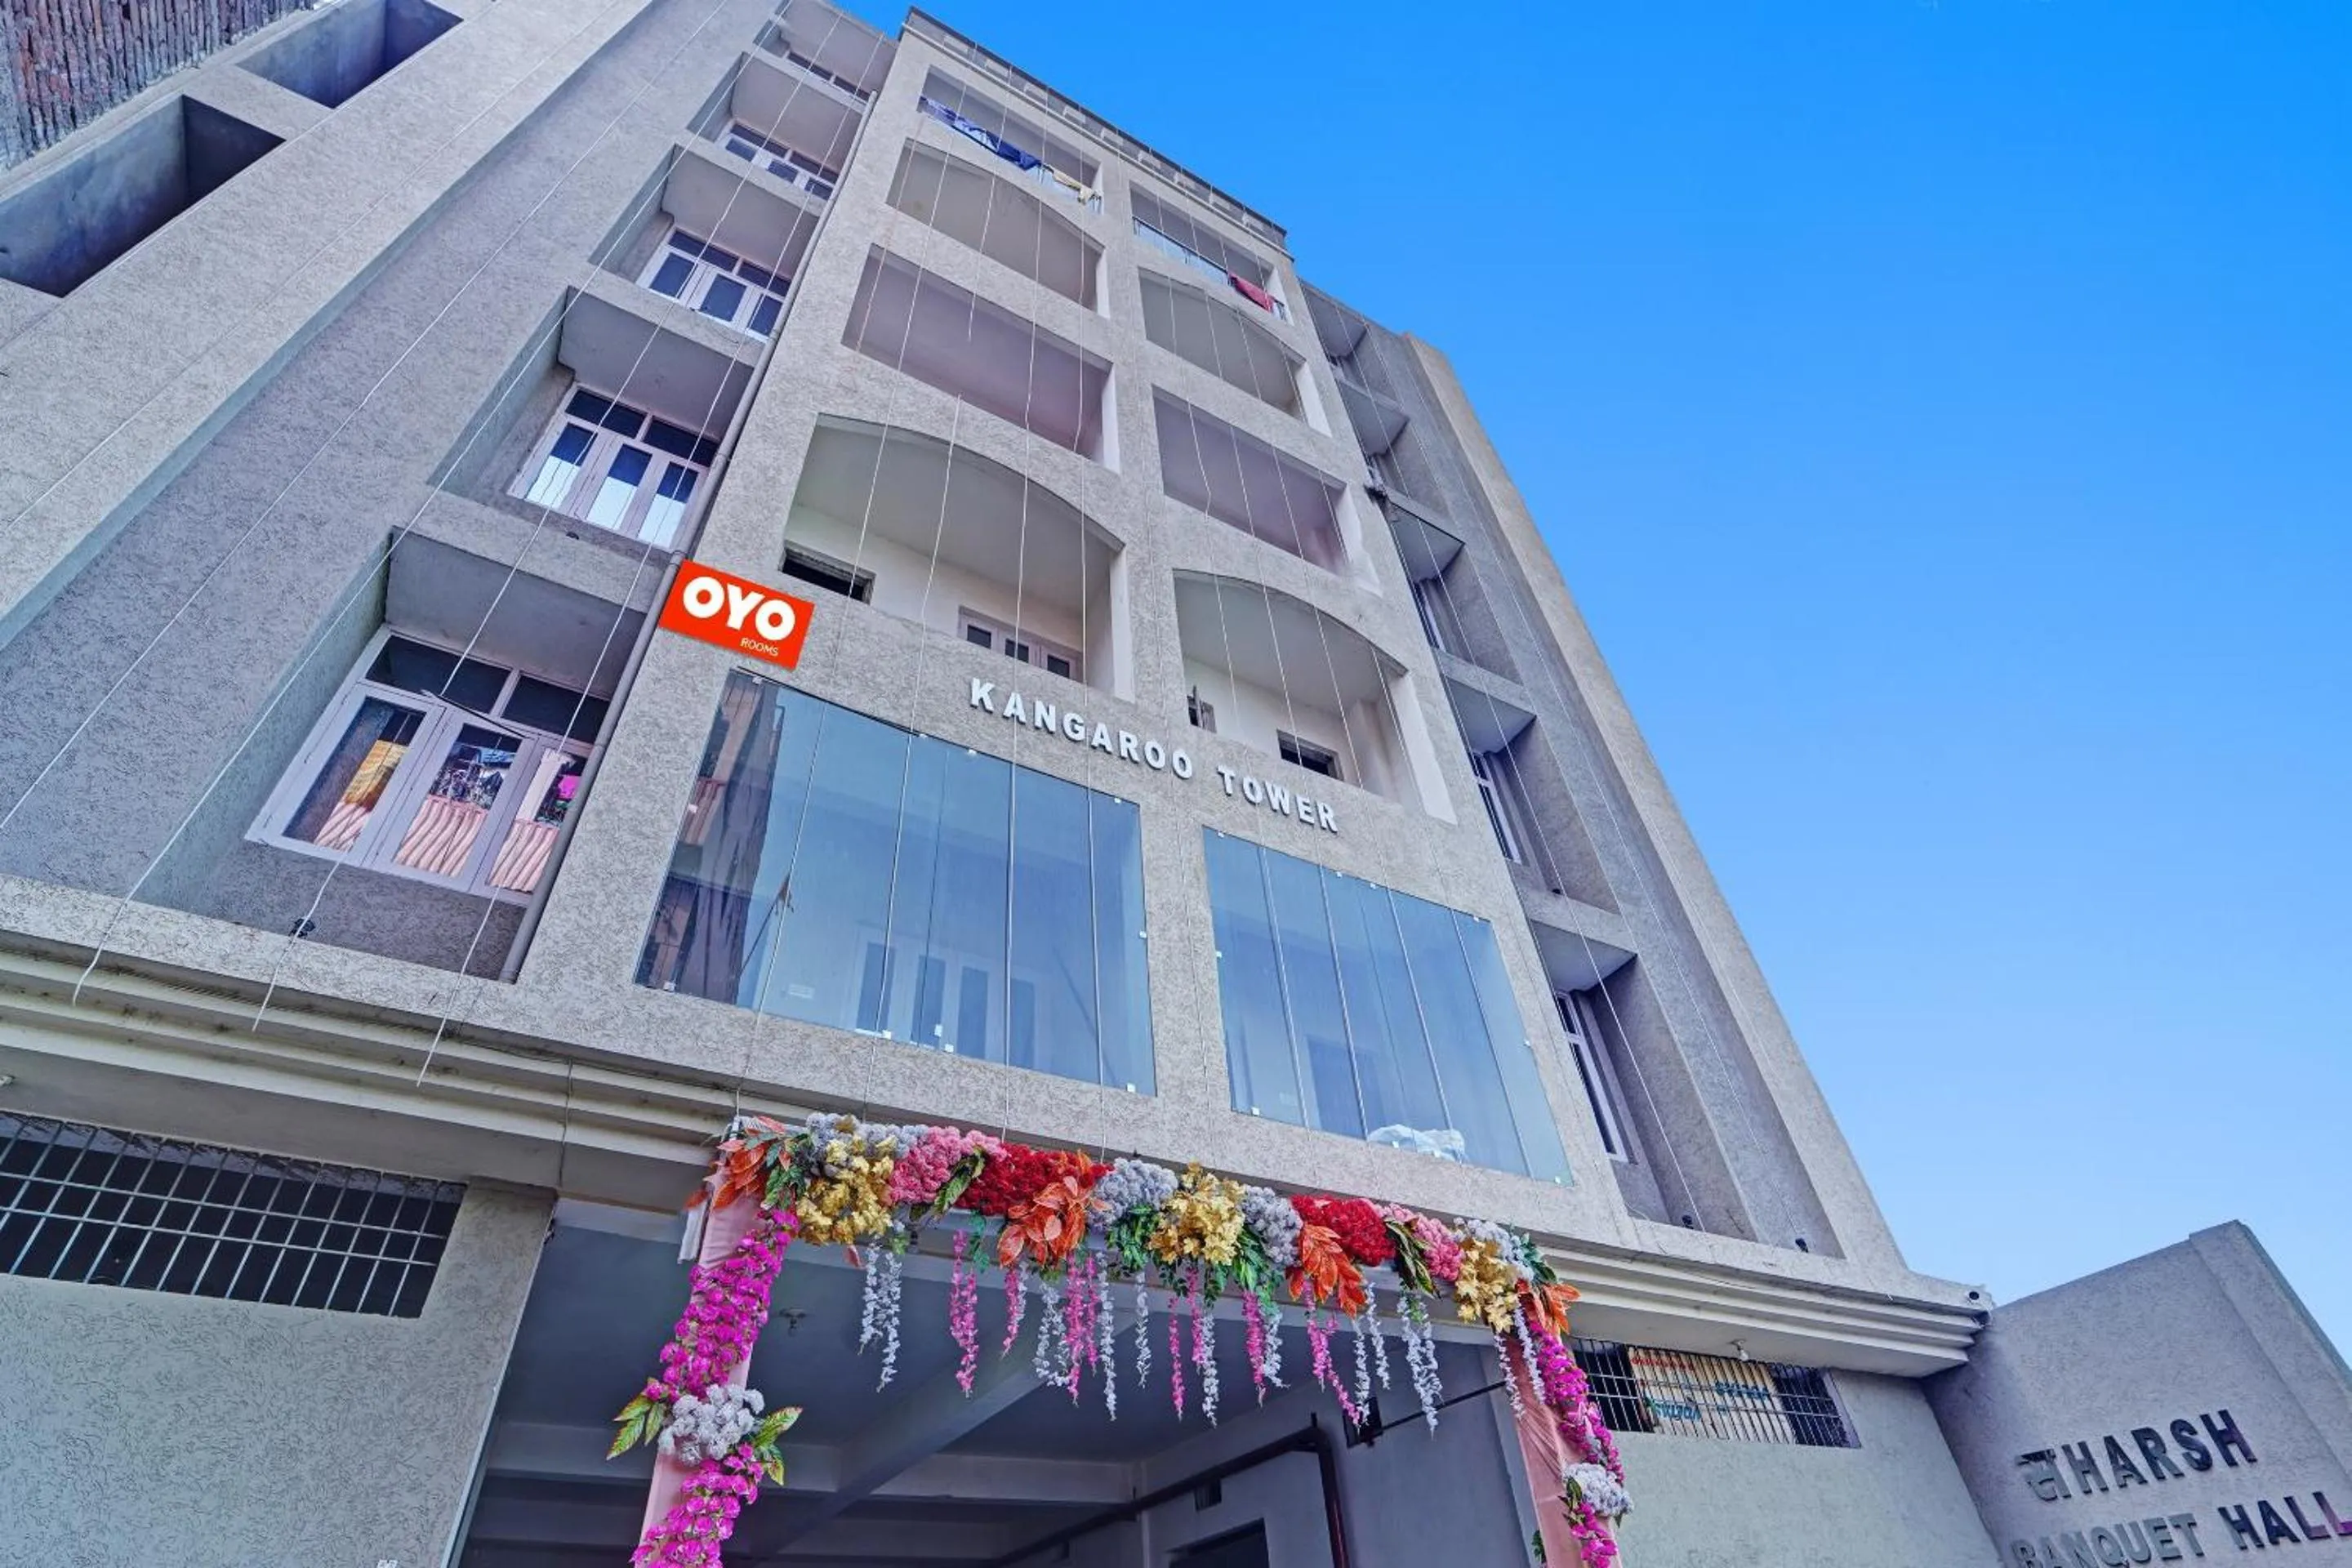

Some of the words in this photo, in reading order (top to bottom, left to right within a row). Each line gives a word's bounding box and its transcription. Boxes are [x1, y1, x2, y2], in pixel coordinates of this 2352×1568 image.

[683, 577, 795, 640] OYO
[740, 637, 778, 657] ROOMS
[969, 678, 1193, 779] KANGAROO
[1217, 765, 1339, 833] TOWER
[2218, 1491, 2352, 1550] HALL
